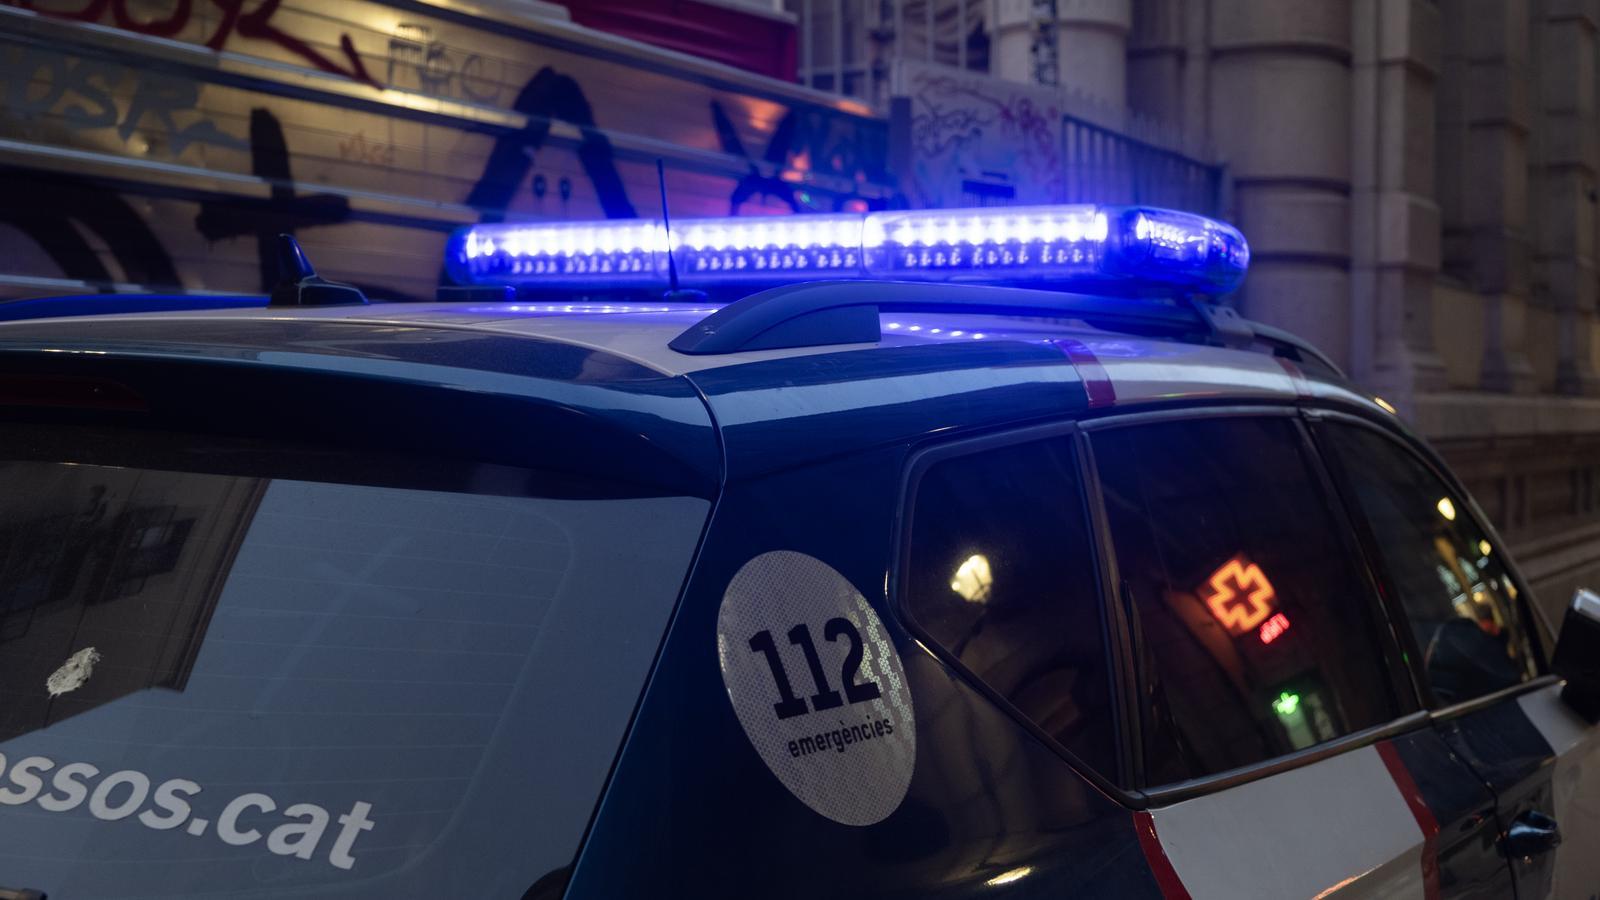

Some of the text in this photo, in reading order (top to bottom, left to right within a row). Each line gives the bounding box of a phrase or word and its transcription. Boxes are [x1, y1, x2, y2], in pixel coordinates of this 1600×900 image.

[749, 617, 882, 720] 112
[788, 714, 894, 758] emergències
[0, 752, 375, 870] ssos.cat
